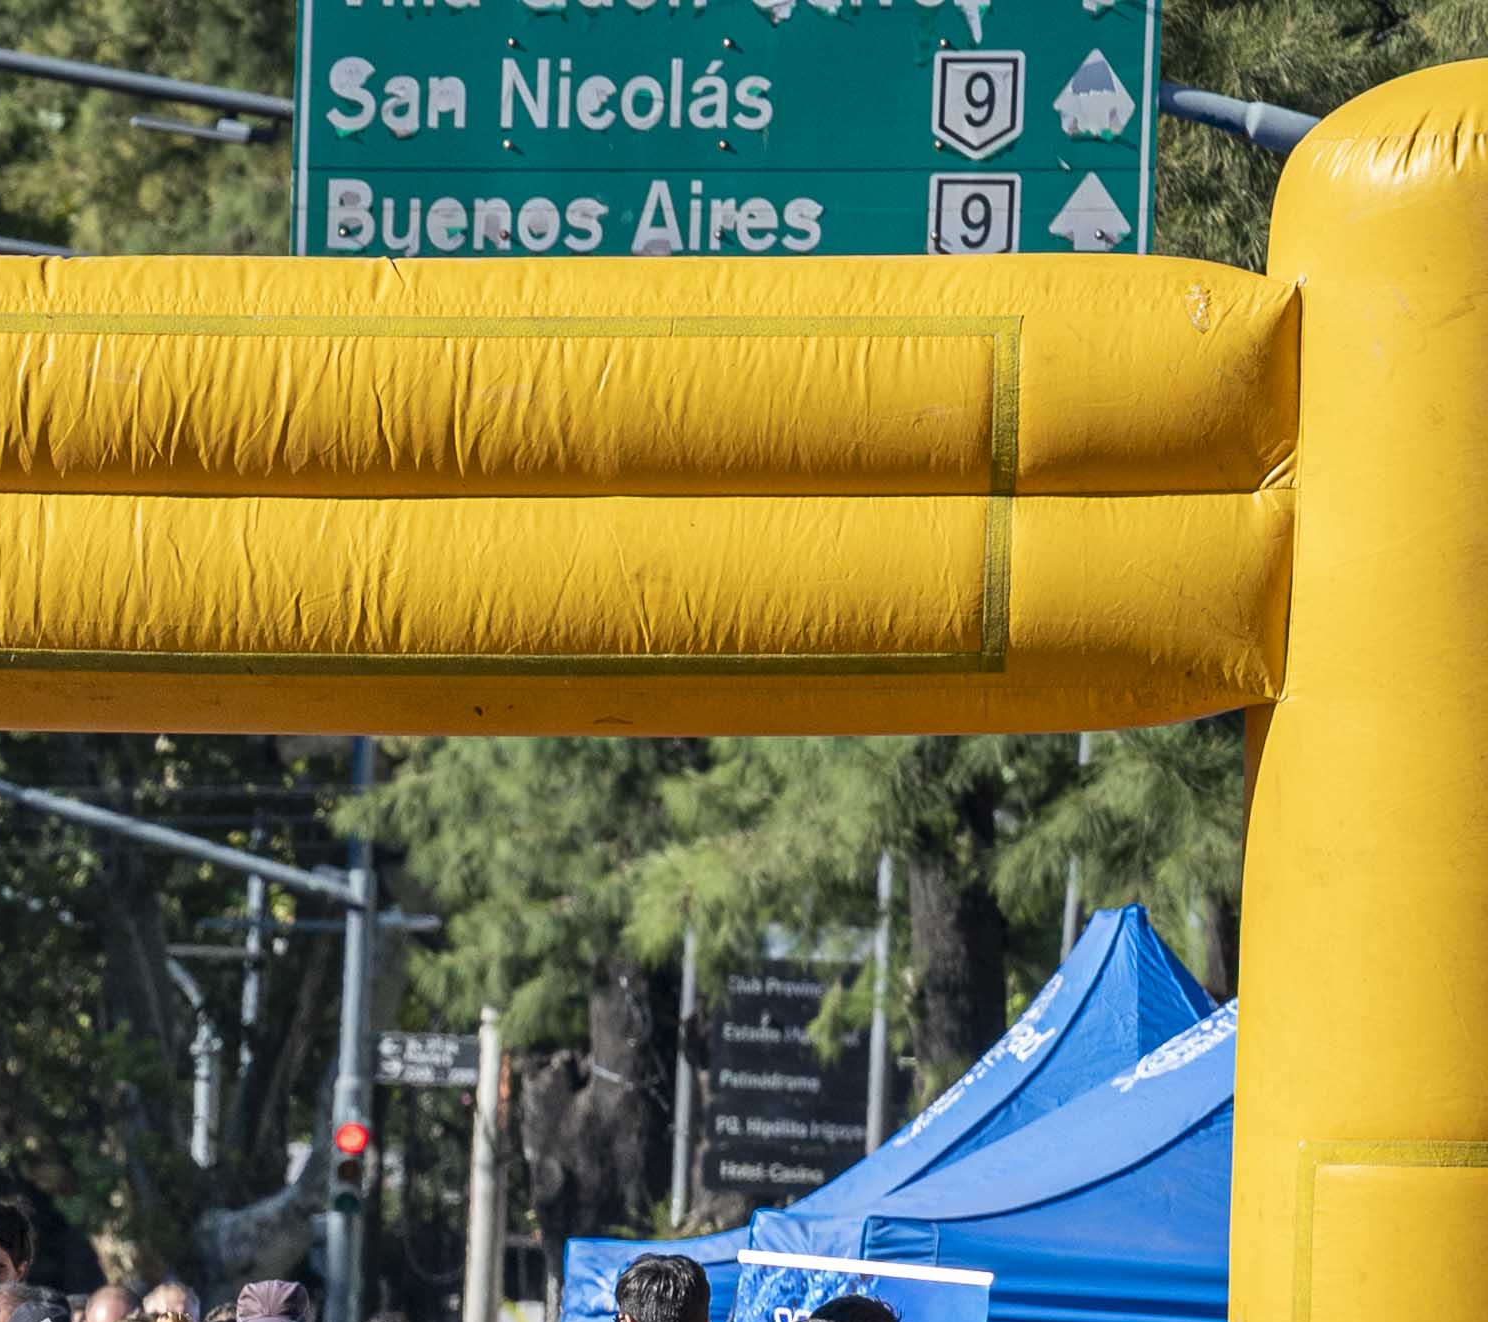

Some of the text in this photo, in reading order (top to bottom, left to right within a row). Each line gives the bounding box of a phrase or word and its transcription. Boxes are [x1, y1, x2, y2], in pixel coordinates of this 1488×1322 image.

[327, 56, 774, 138] San Nicolás
[964, 71, 997, 128] 9
[327, 179, 824, 257] Buenos Aires
[960, 192, 993, 250] 9
